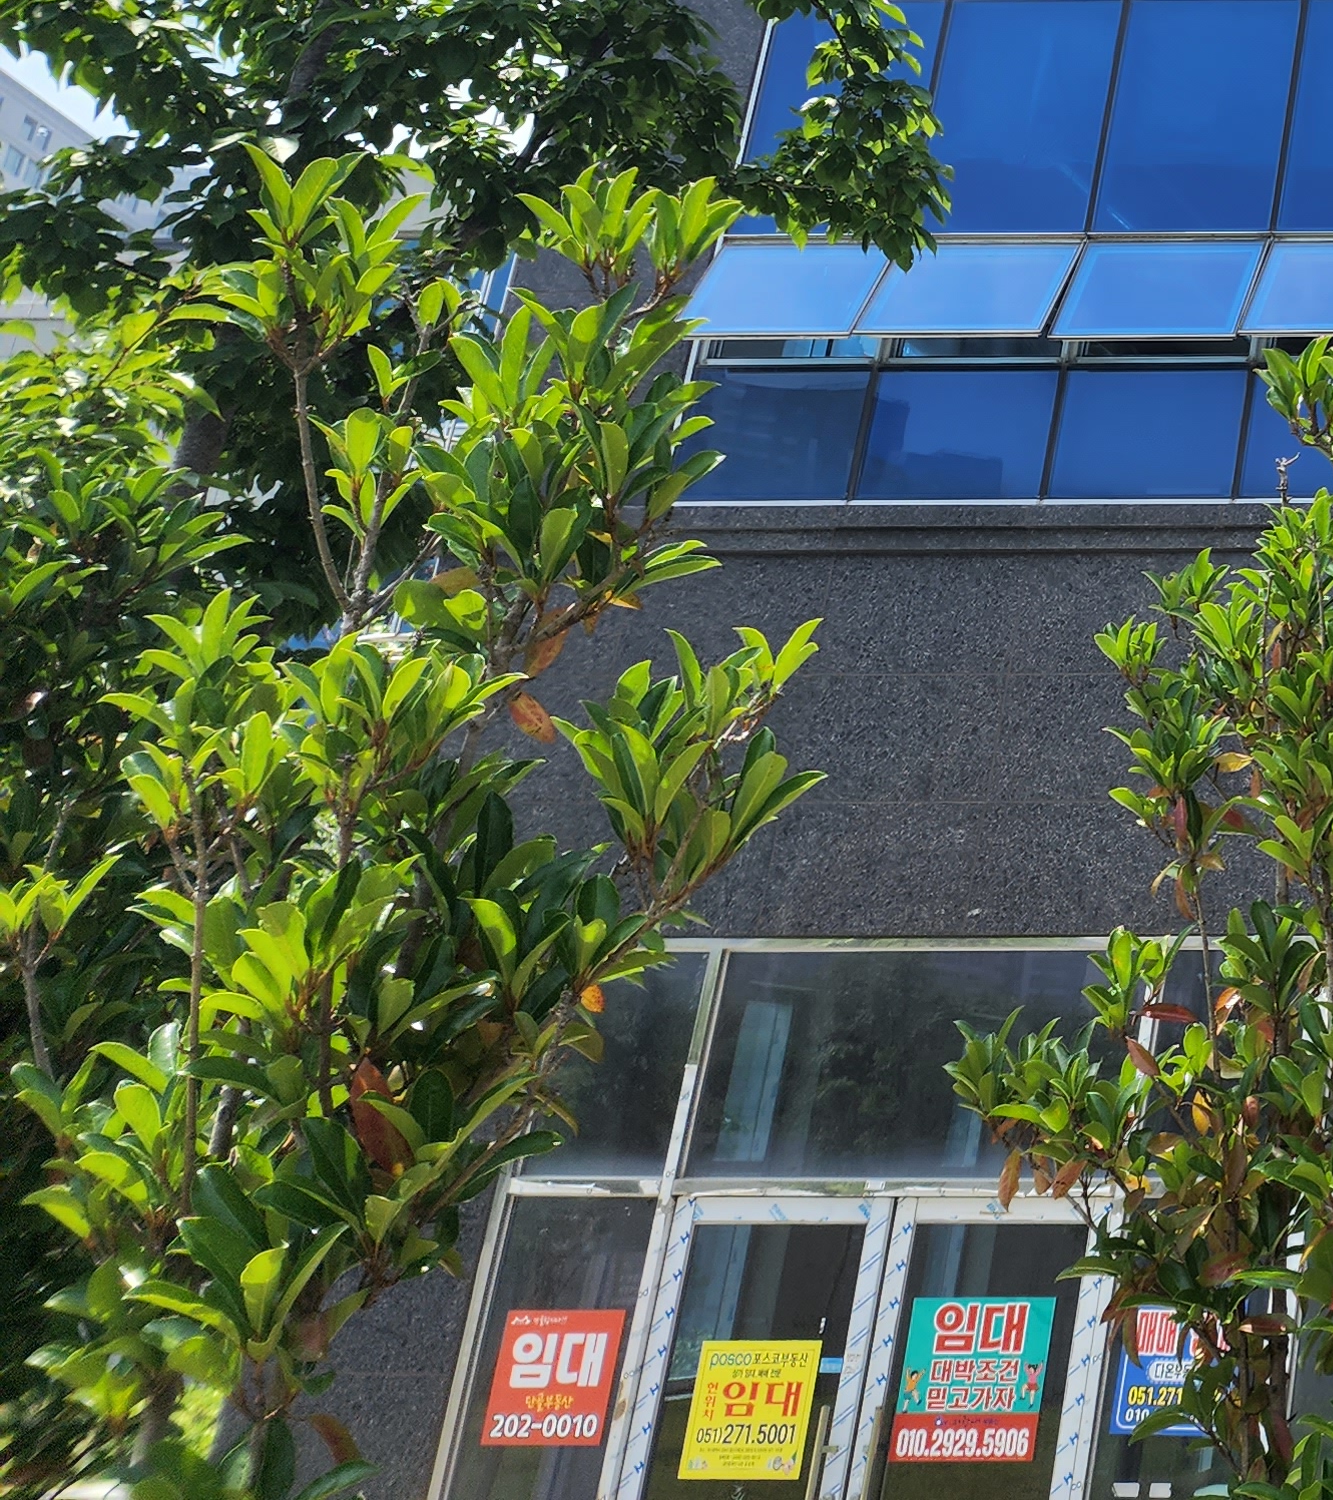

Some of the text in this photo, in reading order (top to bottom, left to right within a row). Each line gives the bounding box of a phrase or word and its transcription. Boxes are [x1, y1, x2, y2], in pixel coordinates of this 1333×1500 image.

[933, 1302, 1030, 1354] 임대
[509, 1332, 608, 1389] 임대
[753, 1352, 808, 1368] 포스코부동산
[930, 1358, 1020, 1384] 대박조건
[722, 1381, 803, 1417] 임대
[926, 1386, 1016, 1411] 믿고가자
[1128, 1386, 1184, 1406] 051.271
[489, 1413, 598, 1438] 202-0010
[696, 1423, 796, 1444] 051)271.5001
[895, 1427, 1030, 1458] 010.2929.5906
